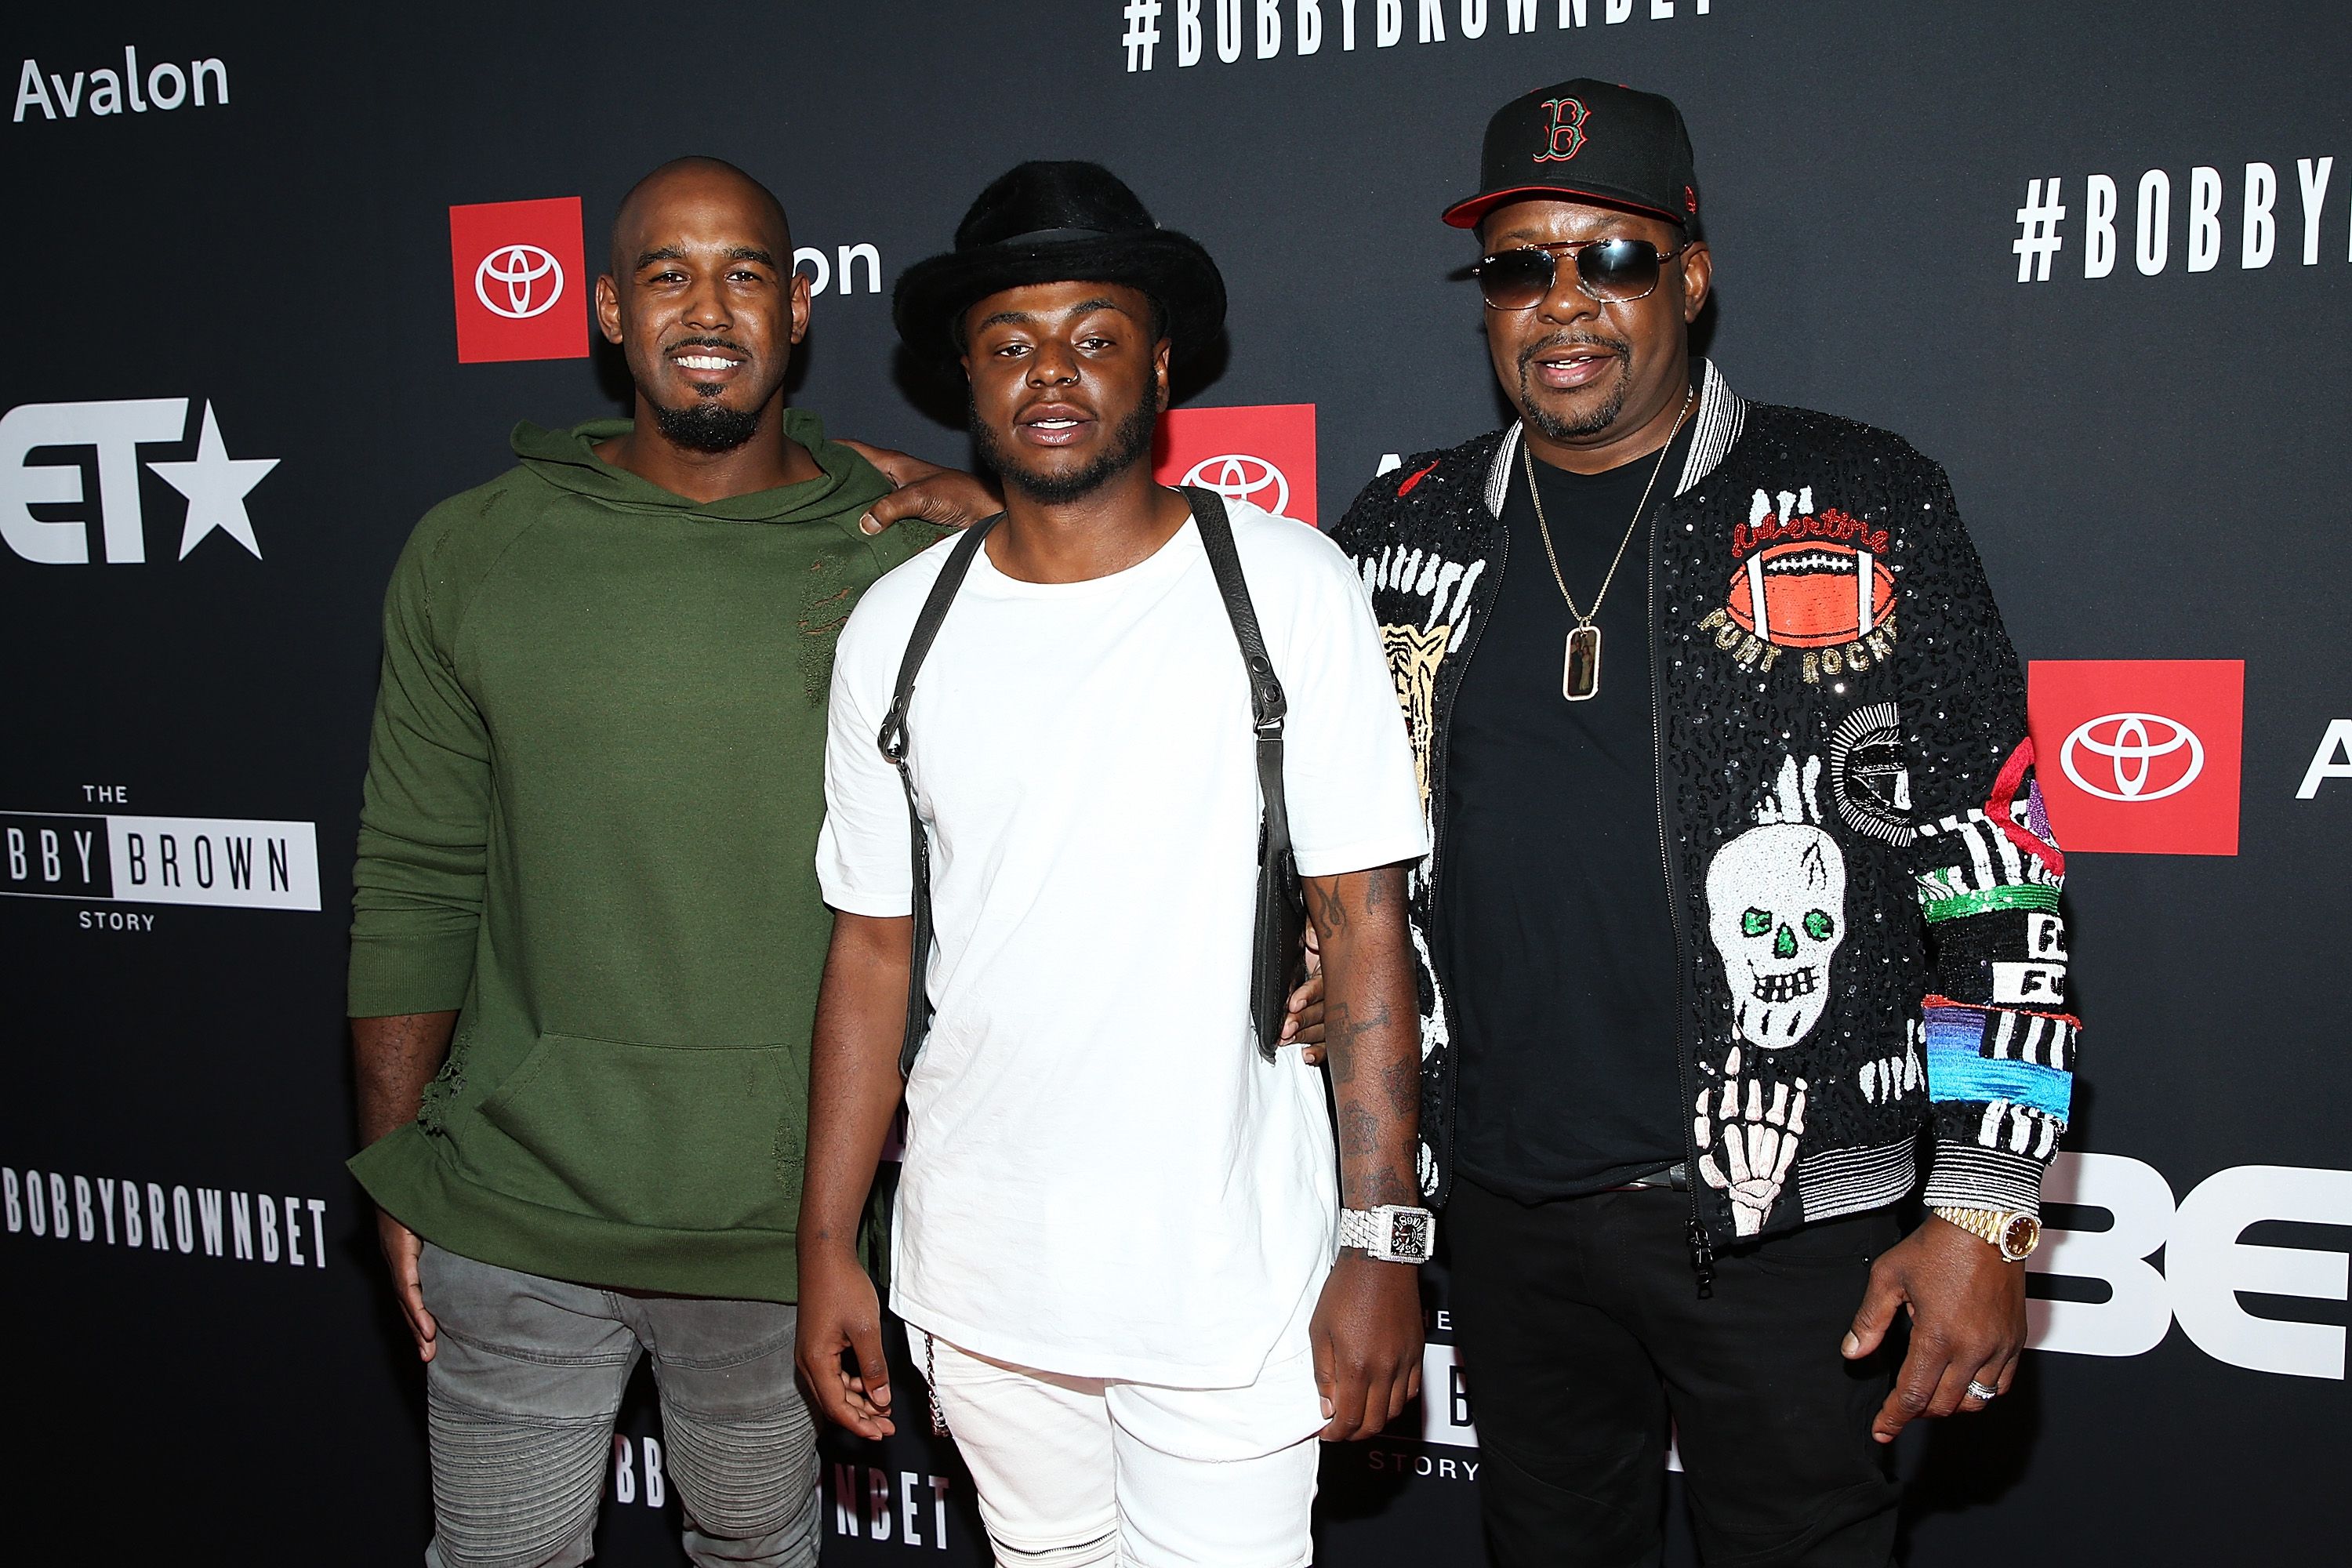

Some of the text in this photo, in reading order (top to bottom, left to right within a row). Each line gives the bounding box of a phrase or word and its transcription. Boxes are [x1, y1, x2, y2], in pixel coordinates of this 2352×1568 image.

[13, 45, 229, 122] Avalon
[1532, 96, 1592, 163] B
[2013, 156, 2352, 283] #BOBBY
[82, 785, 128, 804] THE
[6, 827, 289, 892] BBY BROWN
[80, 910, 154, 931] STORY
[2, 1167, 325, 1269] BOBBYBROWNBET
[1368, 1450, 1480, 1482] STORY
